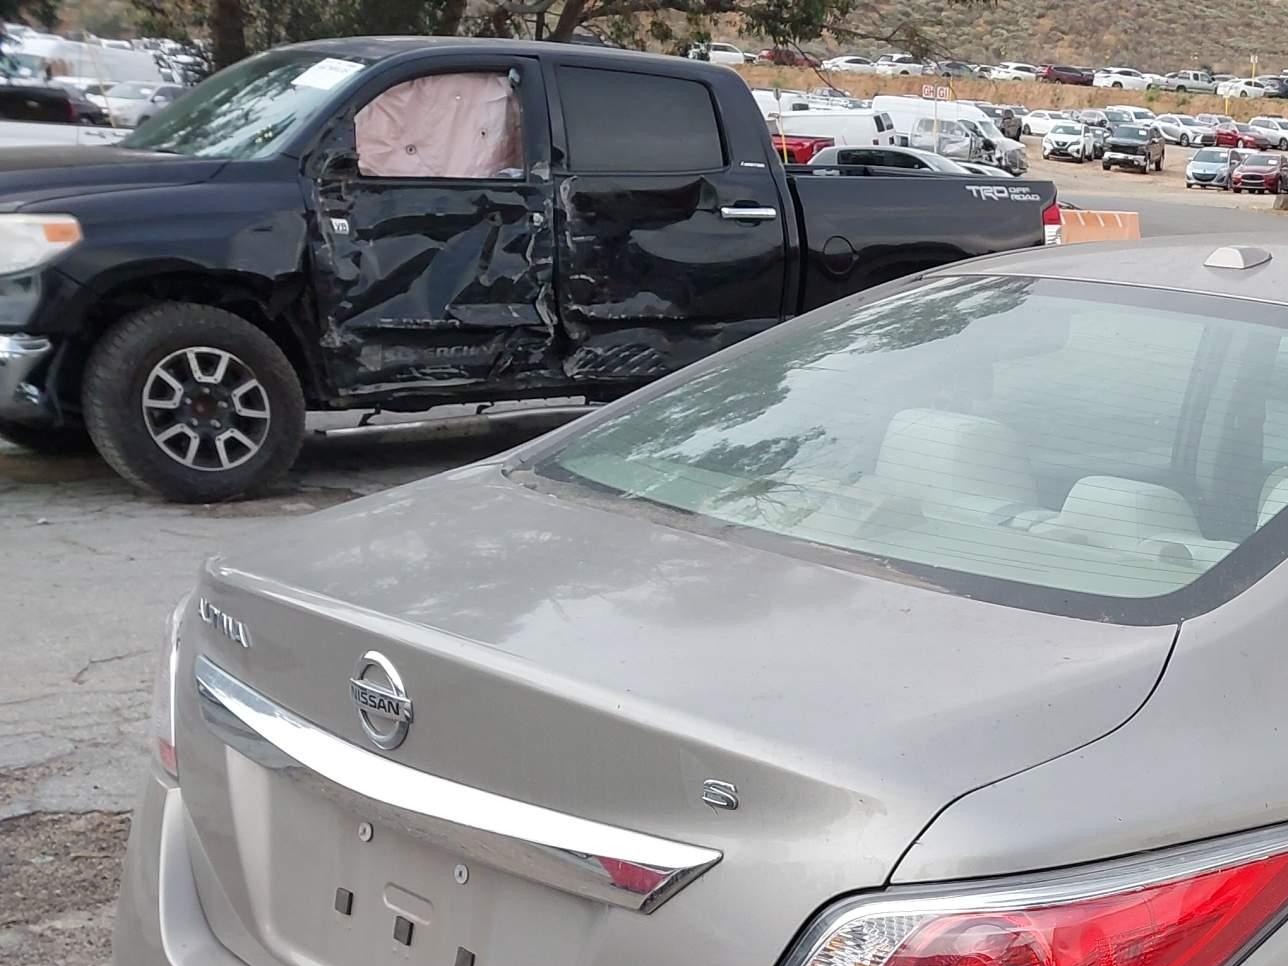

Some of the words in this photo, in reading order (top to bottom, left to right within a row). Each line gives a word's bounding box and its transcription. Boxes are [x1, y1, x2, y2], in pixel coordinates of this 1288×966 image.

[965, 185, 1009, 201] TRD
[1010, 193, 1041, 201] ROAD
[350, 683, 401, 717] NISSAN
[702, 778, 739, 811] S
